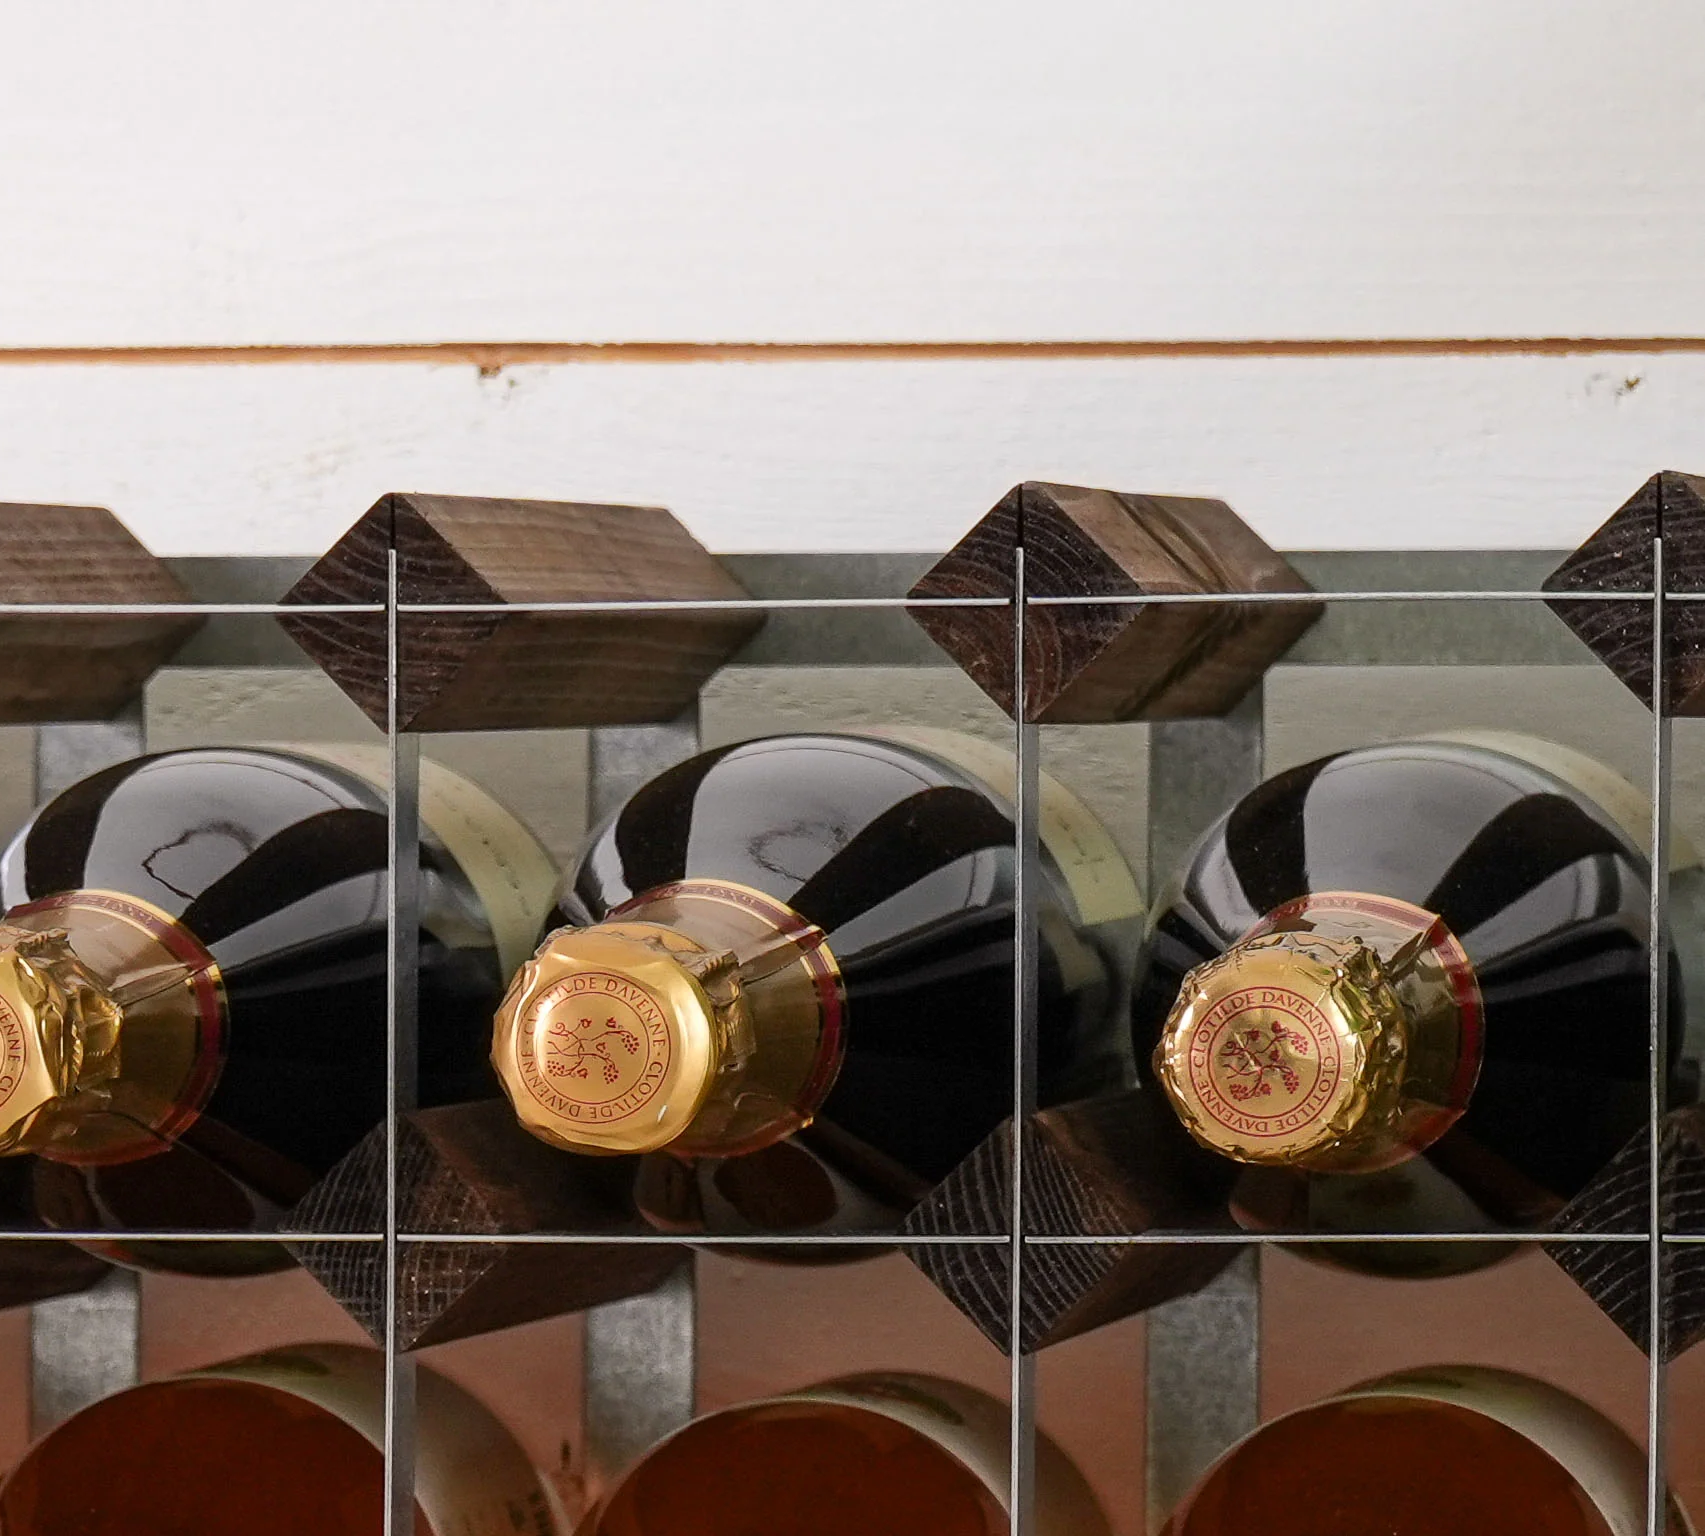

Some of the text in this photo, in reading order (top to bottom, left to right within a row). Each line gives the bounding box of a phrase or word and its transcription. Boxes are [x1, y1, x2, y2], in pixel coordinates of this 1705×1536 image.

[604, 978, 666, 1048] DAVENNE
[1193, 990, 1333, 1068] CLOTILDE DAVENNE
[519, 1050, 664, 1119] CLOTILDE DAVENNE
[1195, 1054, 1336, 1133] CLOTILDE DAVENNE
